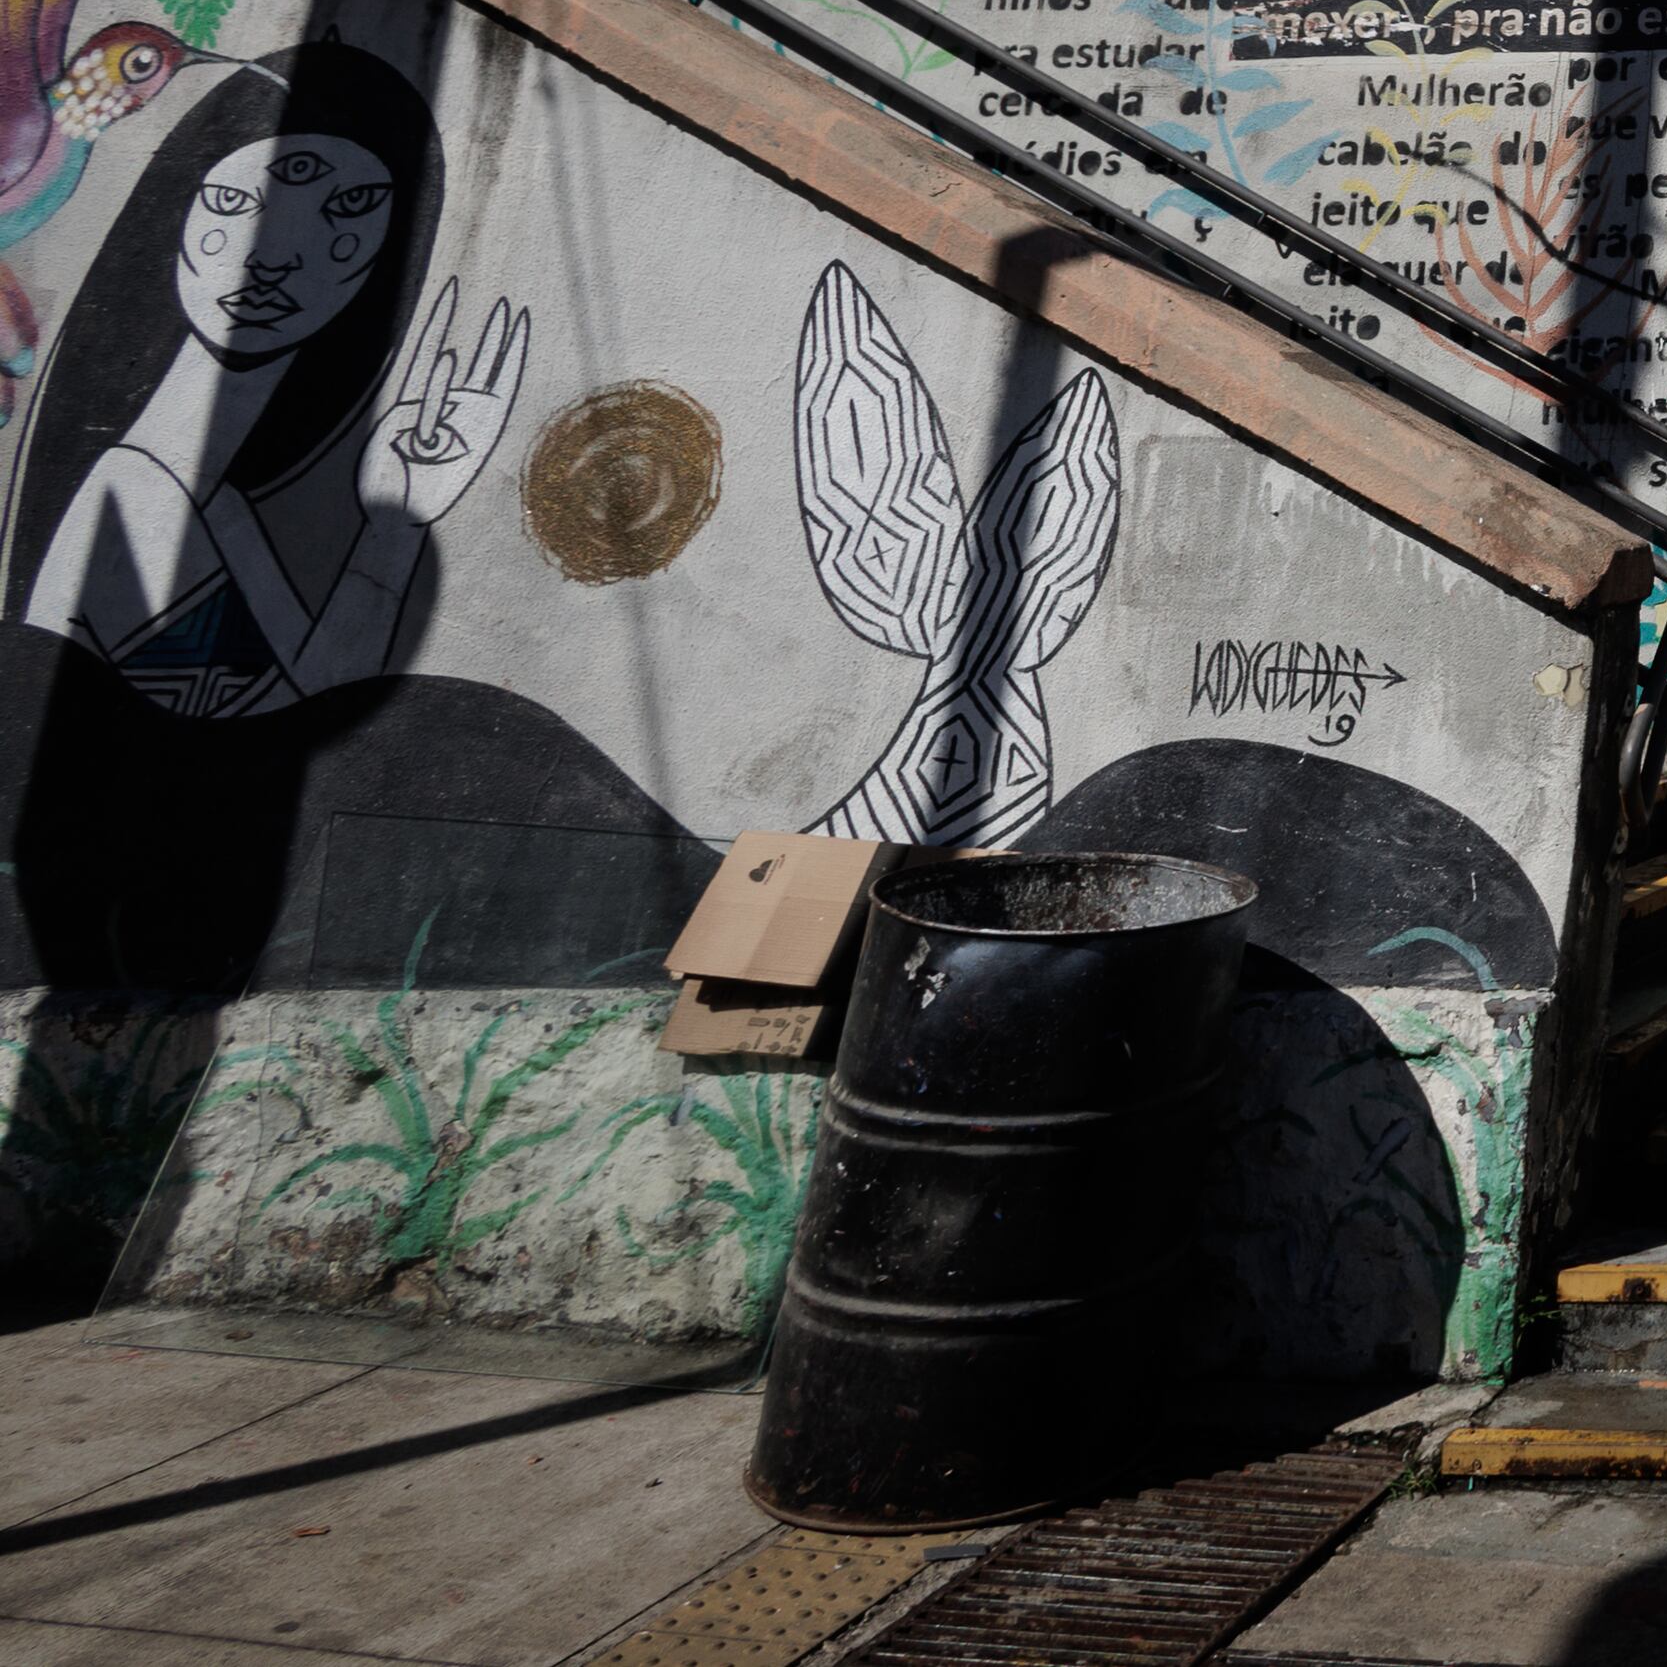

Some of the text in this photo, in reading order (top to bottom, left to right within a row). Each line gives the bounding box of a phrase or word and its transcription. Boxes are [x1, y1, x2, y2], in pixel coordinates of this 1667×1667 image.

[1452, 5, 1525, 46] pra
[1052, 36, 1204, 71] estudar
[1567, 54, 1637, 88] por
[1179, 86, 1228, 116] de
[1357, 72, 1554, 108] Mulherão
[1316, 130, 1548, 168] cabelão do
[1310, 192, 1401, 227] jeito
